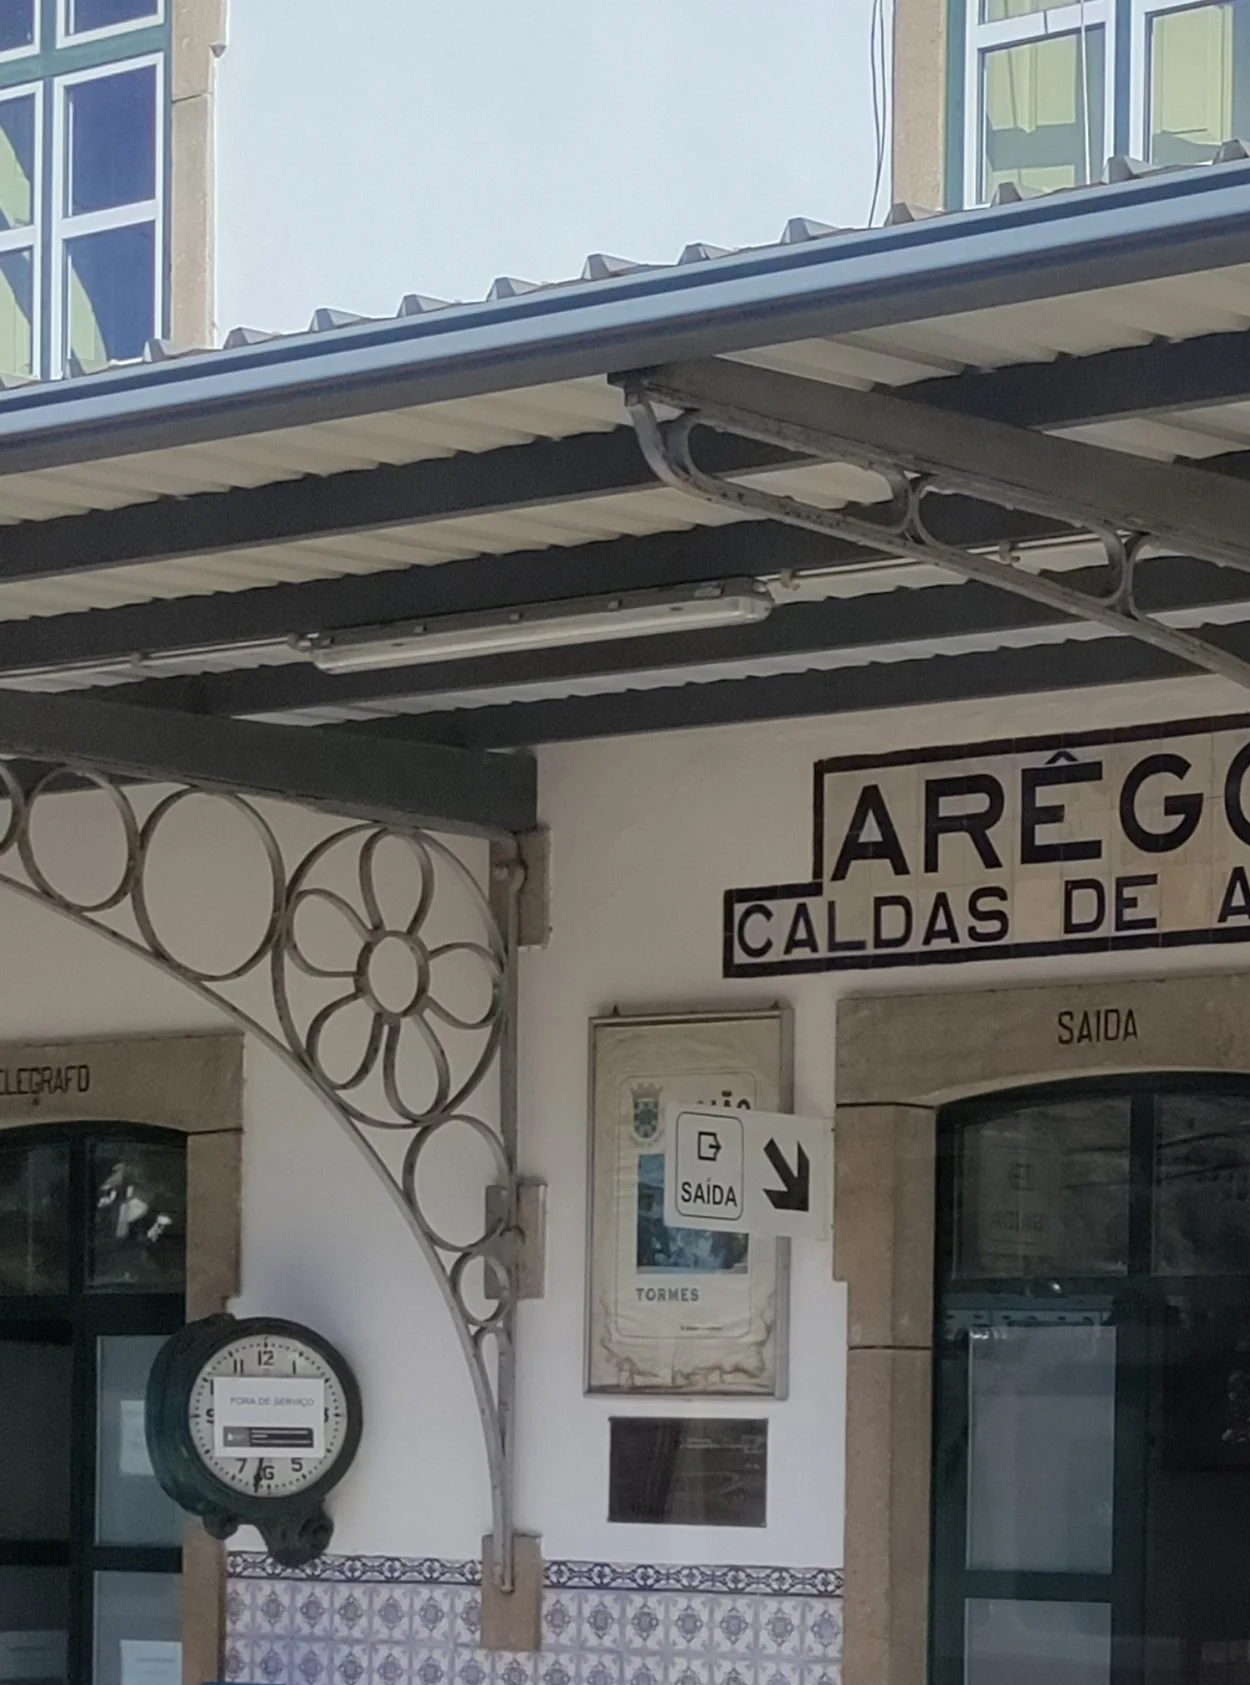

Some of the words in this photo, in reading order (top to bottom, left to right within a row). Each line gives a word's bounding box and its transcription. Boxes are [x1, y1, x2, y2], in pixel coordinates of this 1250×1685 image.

[736, 887, 1010, 959] CALDAS
[1062, 874, 1159, 936] DE
[1058, 1008, 1138, 1045] SAIDA
[680, 1177, 738, 1207] SAÍDA
[635, 1287, 700, 1302] TORMES
[257, 1350, 274, 1366] 12
[236, 1458, 248, 1474] 7
[291, 1458, 304, 1473] 5
